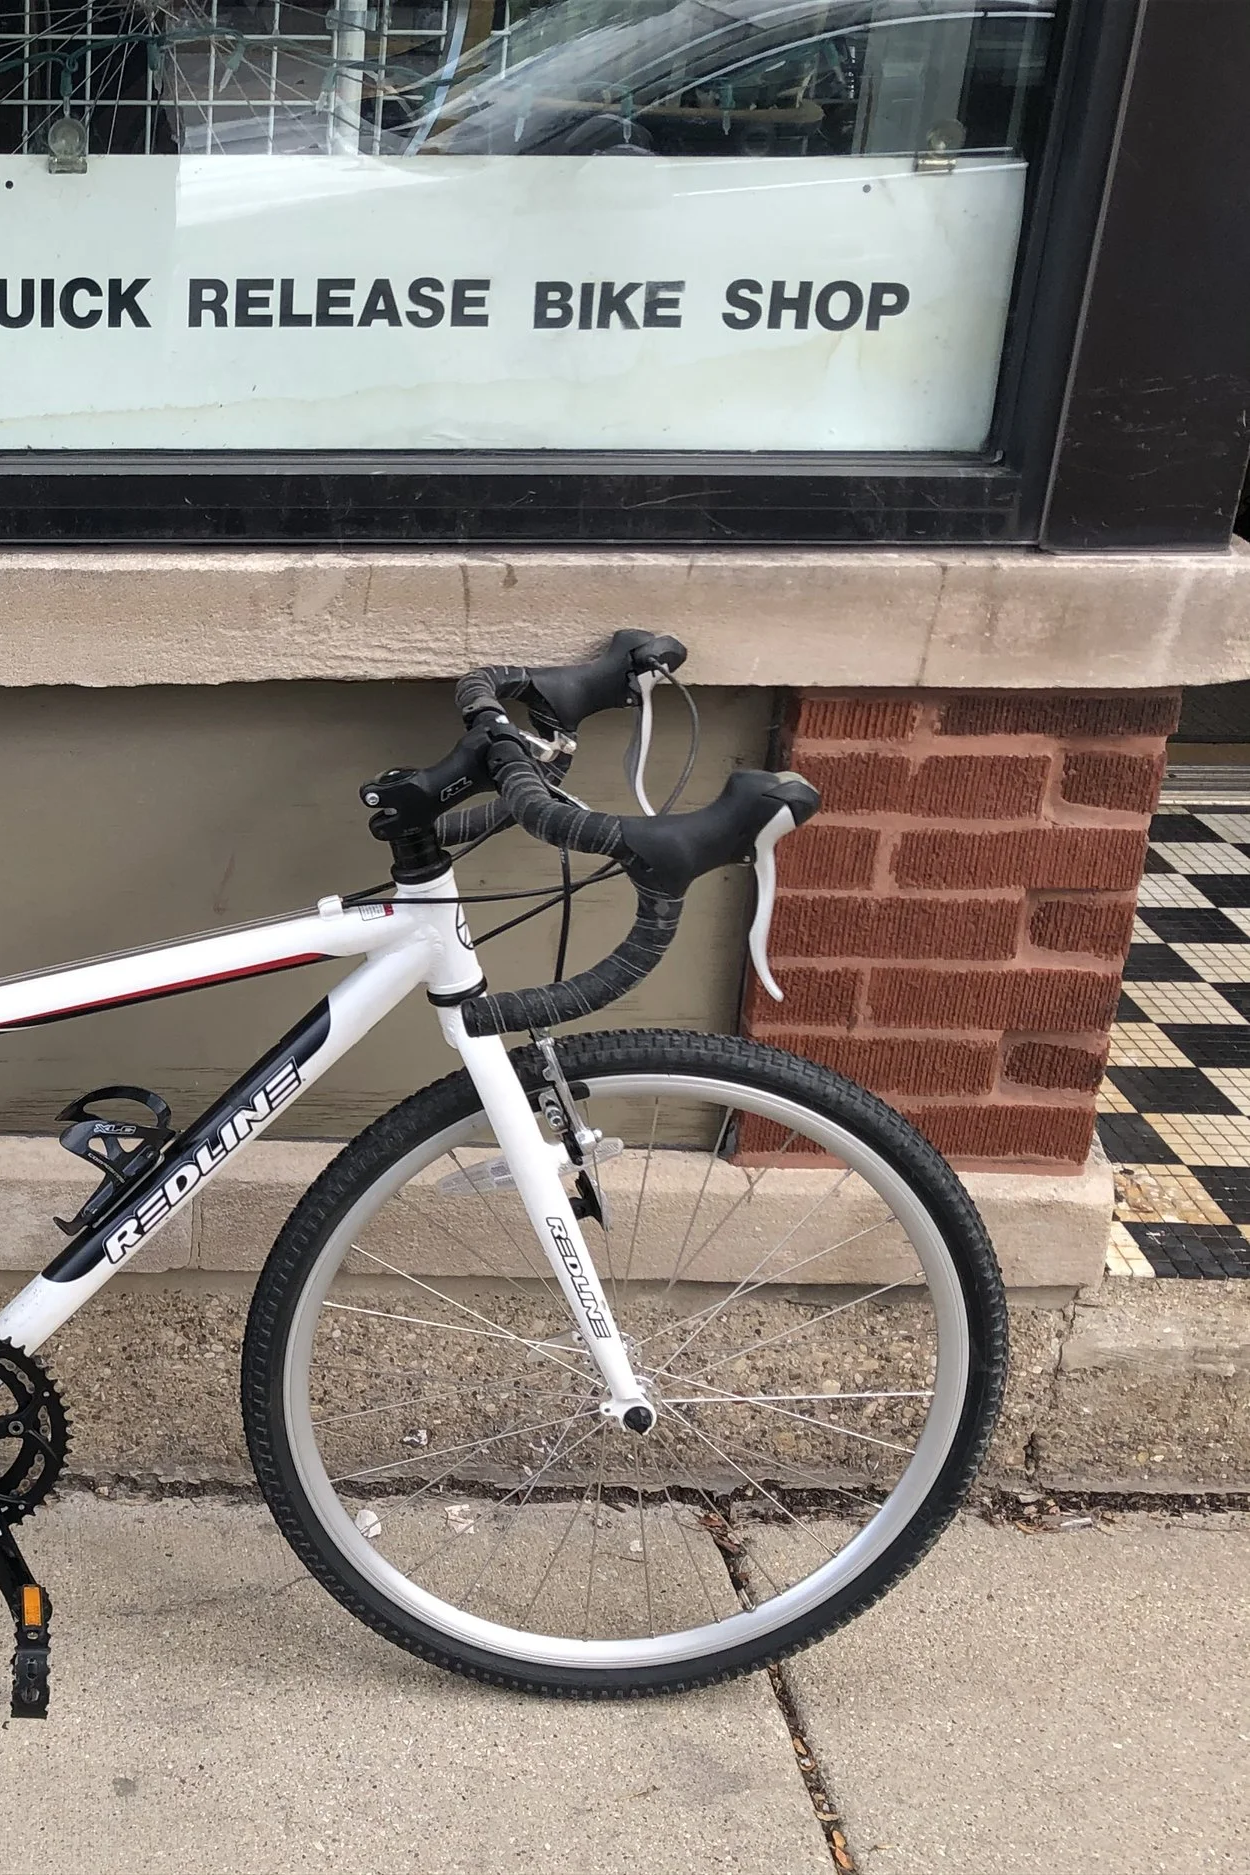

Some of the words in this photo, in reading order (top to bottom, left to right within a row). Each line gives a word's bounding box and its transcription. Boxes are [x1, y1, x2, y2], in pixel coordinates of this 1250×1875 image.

[187, 277, 492, 329] RELEASE
[532, 280, 686, 331] BIKE
[721, 278, 911, 332] SHOP
[93, 1123, 137, 1135] XLC
[102, 1056, 302, 1265] REDLINE
[546, 1217, 612, 1339] REDLINE
